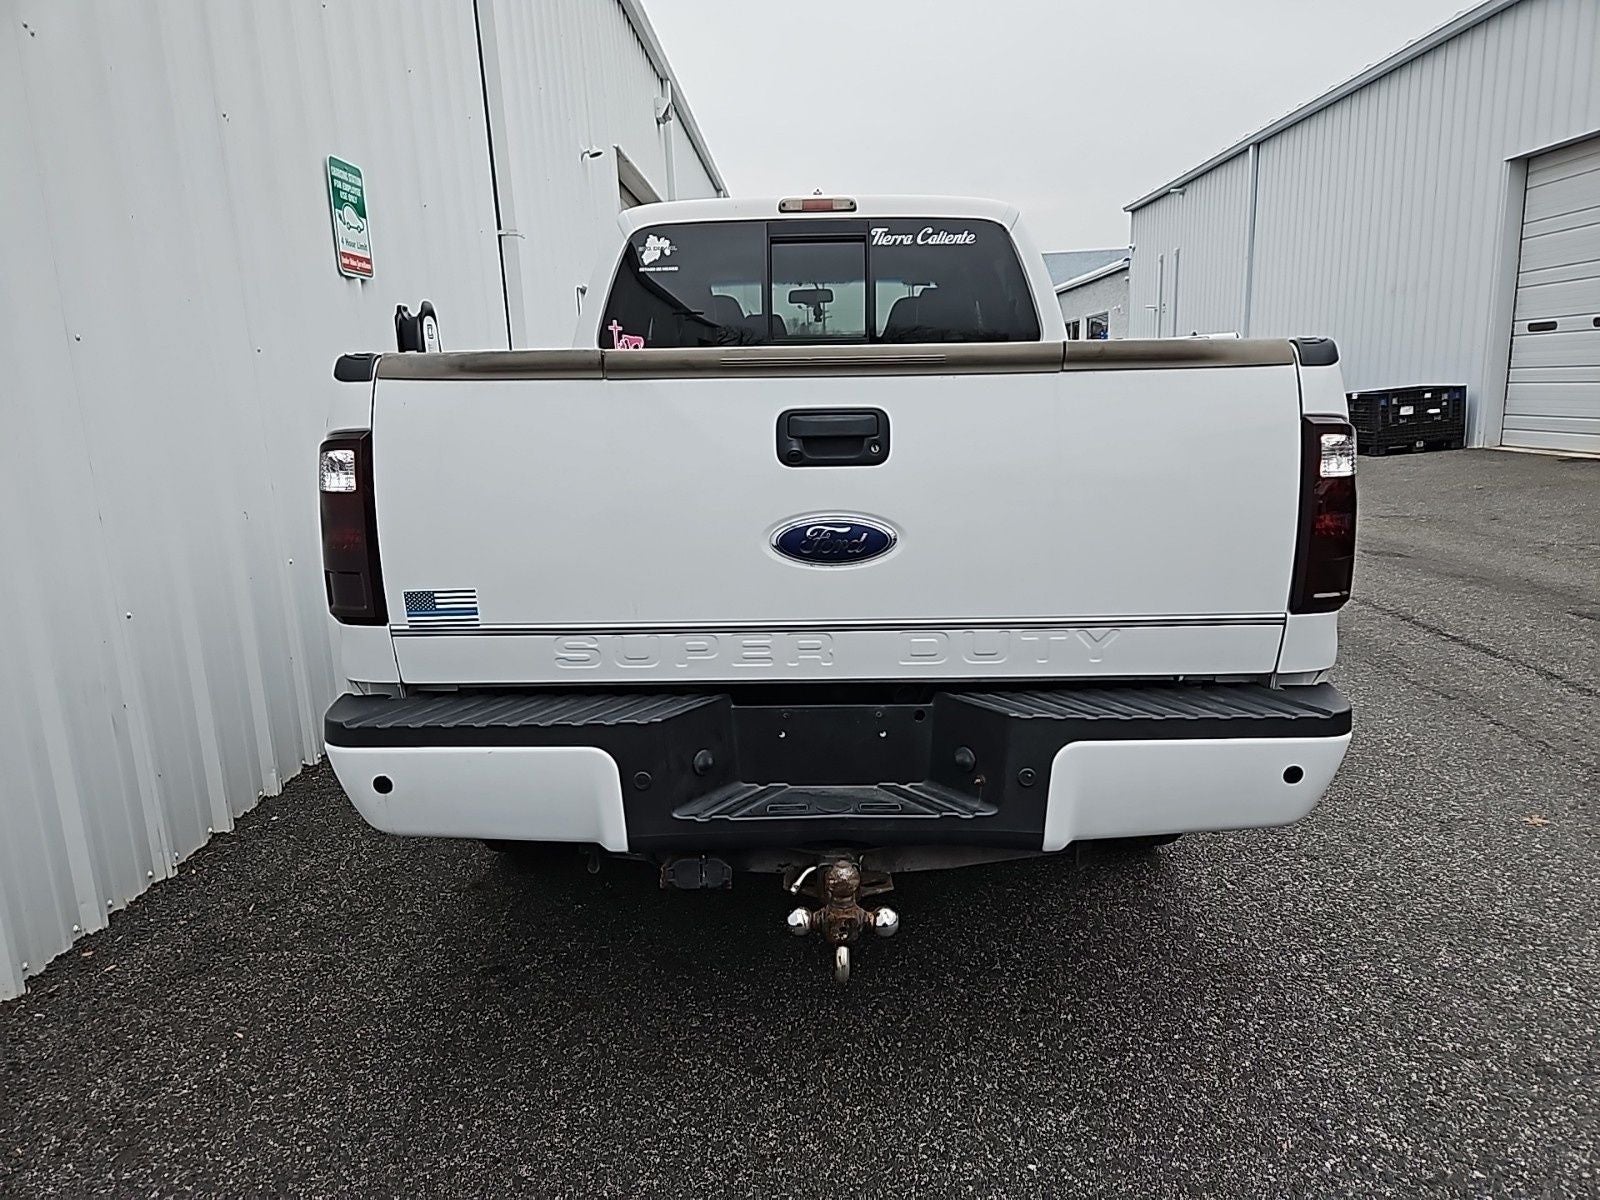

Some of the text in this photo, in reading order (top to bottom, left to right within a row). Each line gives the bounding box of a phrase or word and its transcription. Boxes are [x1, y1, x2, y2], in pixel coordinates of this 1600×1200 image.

[345, 237, 356, 249] Hour
[357, 241, 368, 252] Limit
[870, 226, 977, 246] Tierra Caliente
[799, 525, 869, 554] Ford
[553, 627, 1121, 670] SUPER DUTY
